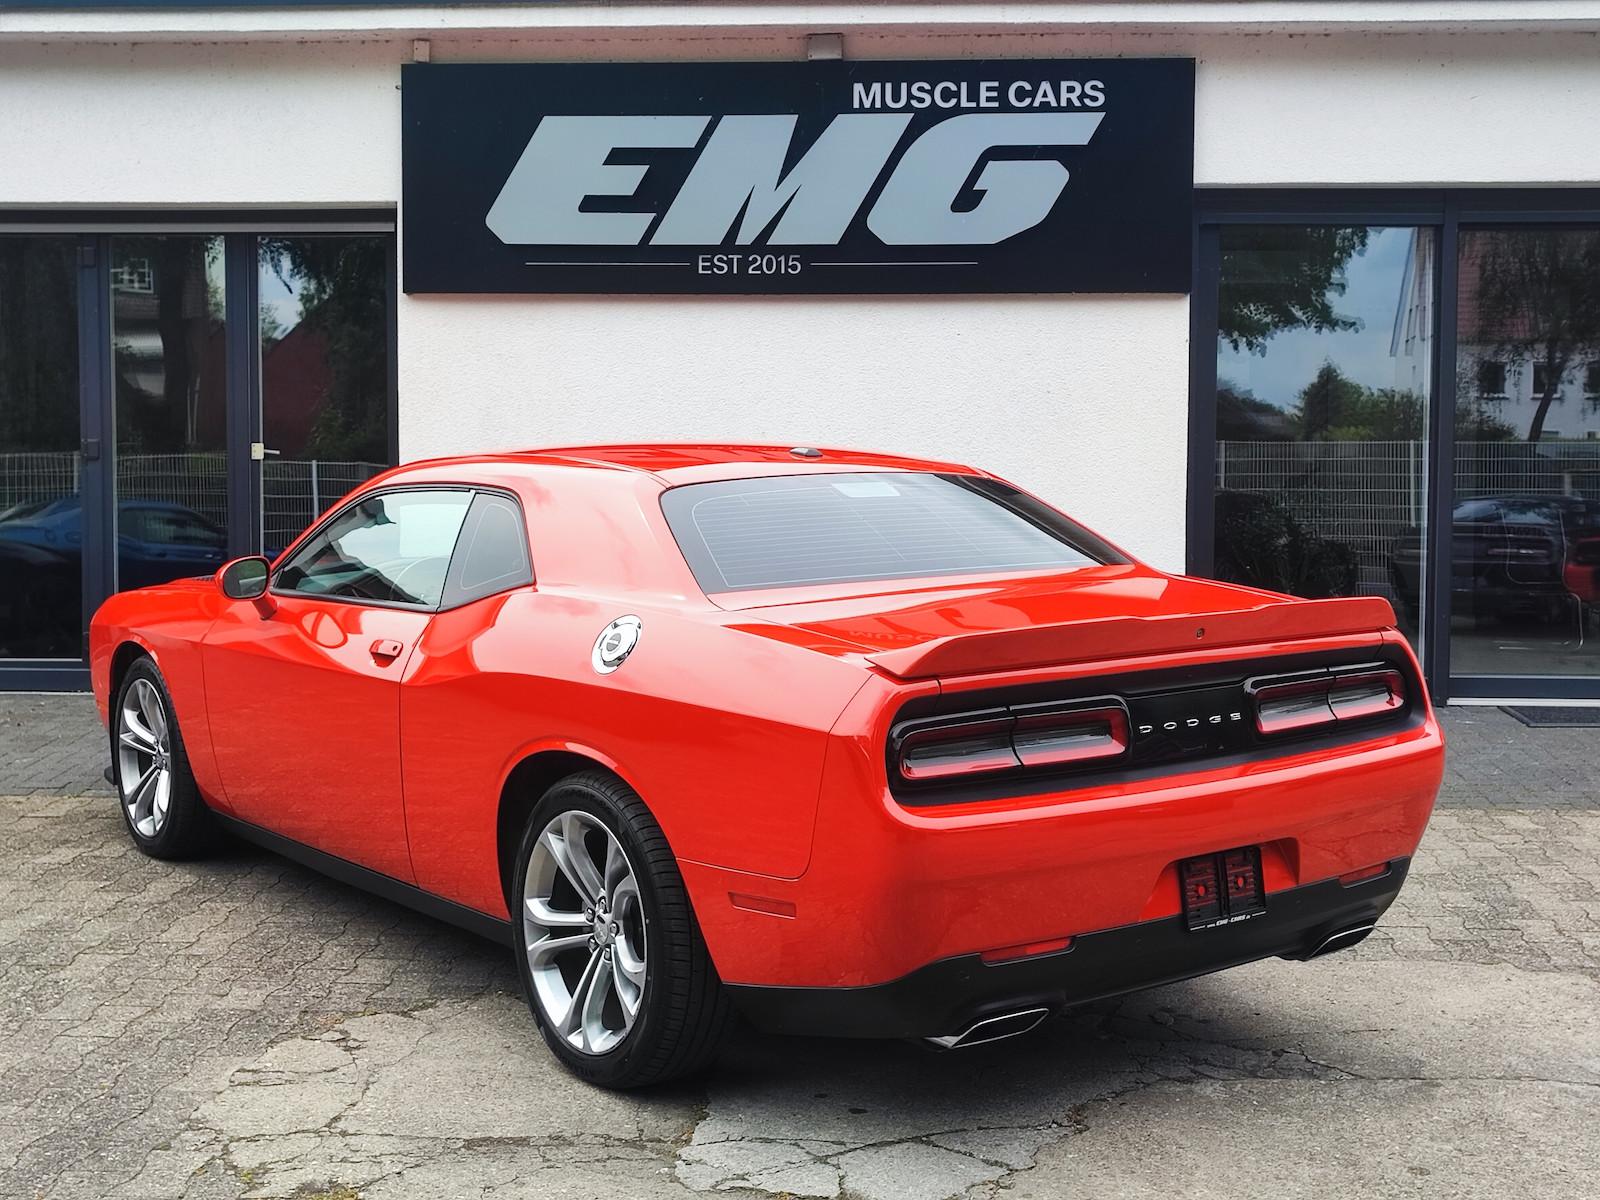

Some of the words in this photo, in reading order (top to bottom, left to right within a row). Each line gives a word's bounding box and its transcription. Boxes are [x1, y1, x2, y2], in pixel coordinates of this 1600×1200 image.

[852, 81, 1000, 109] MUSCLE
[1007, 79, 1106, 108] CARS
[486, 111, 1106, 246] EMG
[697, 254, 743, 276] EST
[747, 254, 803, 276] 2015
[1138, 712, 1242, 734] DODGE
